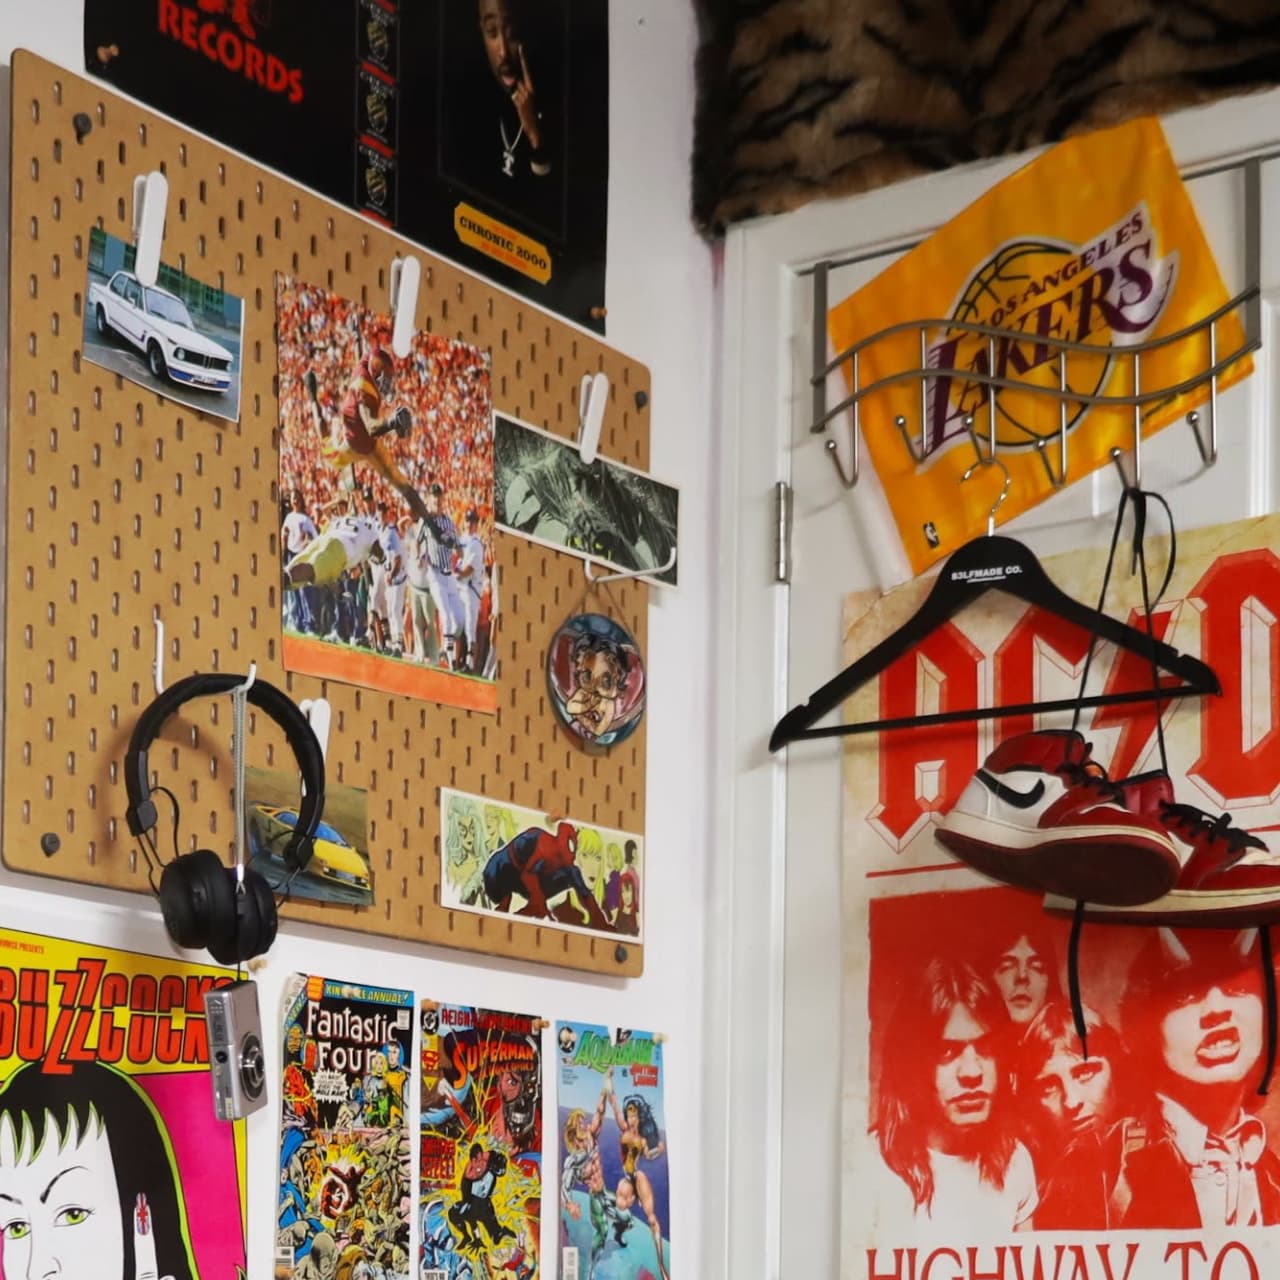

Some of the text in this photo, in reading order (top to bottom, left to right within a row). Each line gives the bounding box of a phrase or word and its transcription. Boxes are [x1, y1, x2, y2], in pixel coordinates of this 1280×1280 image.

[158, 0, 304, 104] RECORDS
[459, 215, 515, 253] CHRONIC
[515, 245, 547, 270] 2000
[1020, 211, 1144, 305] ANGELES
[916, 239, 1175, 459] LAKERS
[1005, 565, 1023, 575] CO.
[305, 1000, 399, 1044] Fantastic
[317, 1041, 378, 1075] Four
[453, 1041, 535, 1089] SUPERMAN
